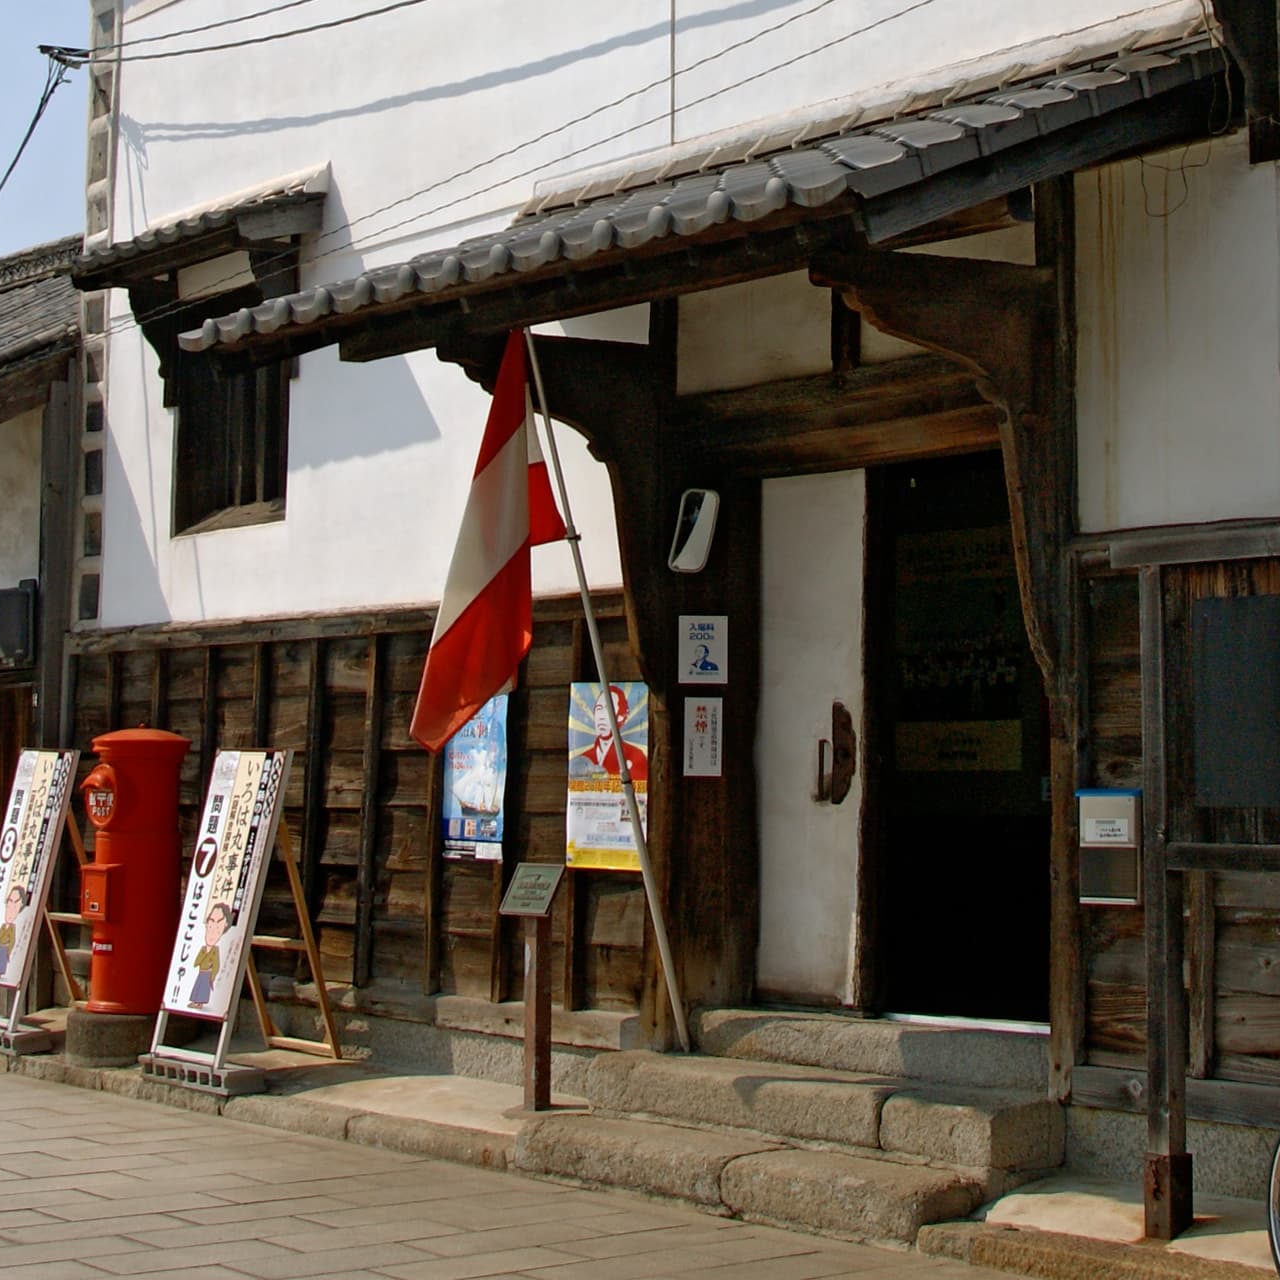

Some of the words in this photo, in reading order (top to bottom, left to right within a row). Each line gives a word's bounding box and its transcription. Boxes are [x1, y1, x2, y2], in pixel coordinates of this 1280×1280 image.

[19, 760, 54, 881] いろは丸事件
[92, 806, 110, 816] POST
[220, 760, 260, 899] いろは丸事件
